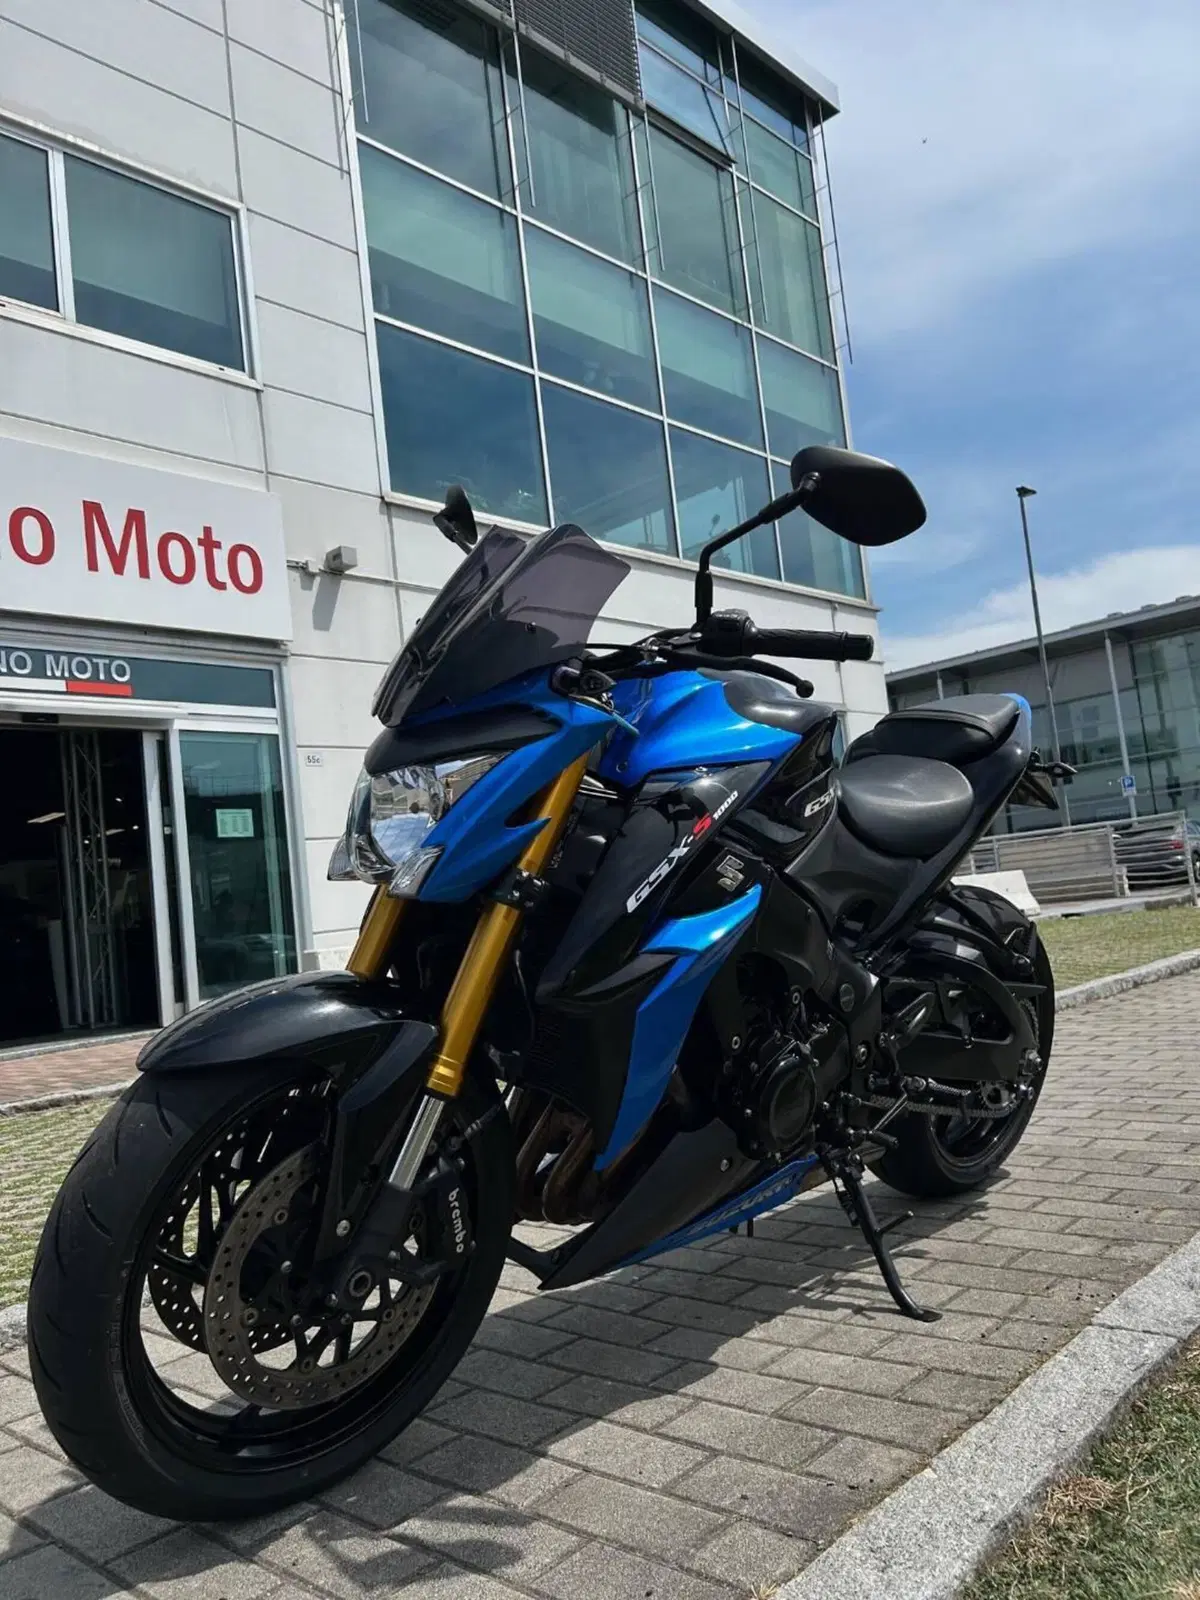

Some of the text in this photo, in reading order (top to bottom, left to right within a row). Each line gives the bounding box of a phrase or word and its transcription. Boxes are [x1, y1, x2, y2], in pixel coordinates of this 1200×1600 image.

[82, 499, 263, 595] Moto
[46, 654, 131, 682] MOTO
[448, 1187, 467, 1253] brembo
